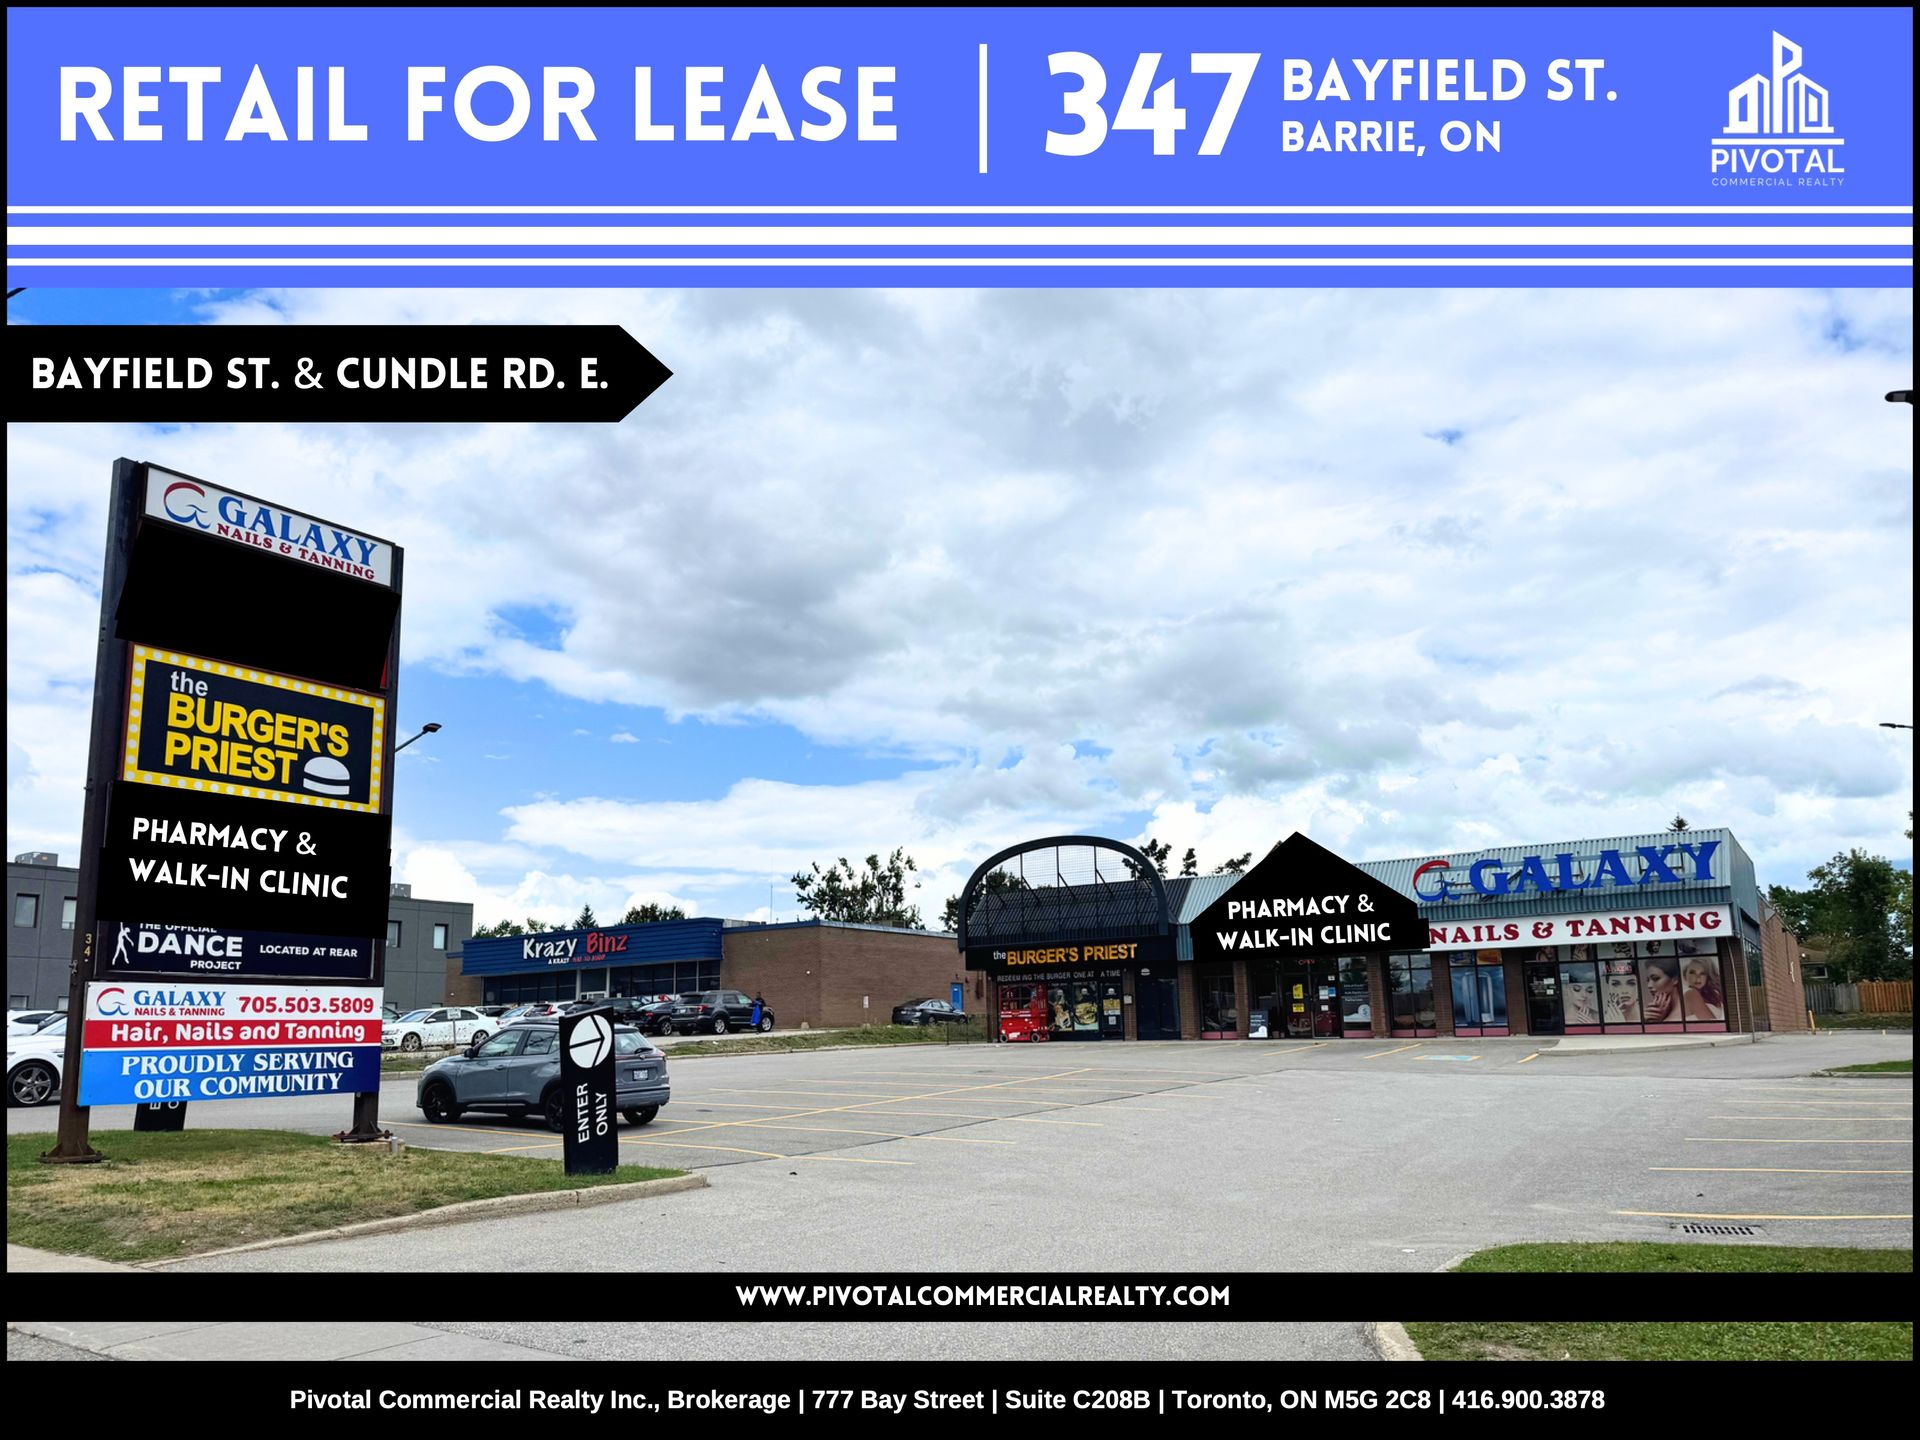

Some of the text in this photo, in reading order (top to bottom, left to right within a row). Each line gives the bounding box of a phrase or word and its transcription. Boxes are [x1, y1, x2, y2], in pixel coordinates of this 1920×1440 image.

[218, 496, 378, 566] GALAXY
[218, 523, 375, 580] NAILS & TANNING
[170, 671, 208, 697] the
[168, 695, 349, 757] BURGER'S
[165, 733, 298, 784] PRIEST
[1469, 840, 1722, 895] GALAXY
[1429, 911, 1722, 944] NAILS & TANNING
[138, 932, 243, 957] DANCE
[260, 945, 358, 957] LOCATED AT REAR
[523, 932, 628, 959] Krazy Binz
[994, 944, 1137, 965] the BURGER'S PRIEST
[190, 960, 242, 970] PROJECT
[1046, 972, 1071, 980] BURGER
[134, 990, 225, 1006] GALAXY
[238, 996, 374, 1014] 705.503.5809
[134, 1007, 225, 1016] NAILS & TANNING
[111, 1022, 365, 1043] Hair, Nails and Tanning
[122, 1052, 354, 1076] PROUDLY SERVING
[134, 1072, 343, 1099] OUR COMMUNITY
[577, 1083, 589, 1143] ENTER
[596, 1092, 607, 1136] ONLY
